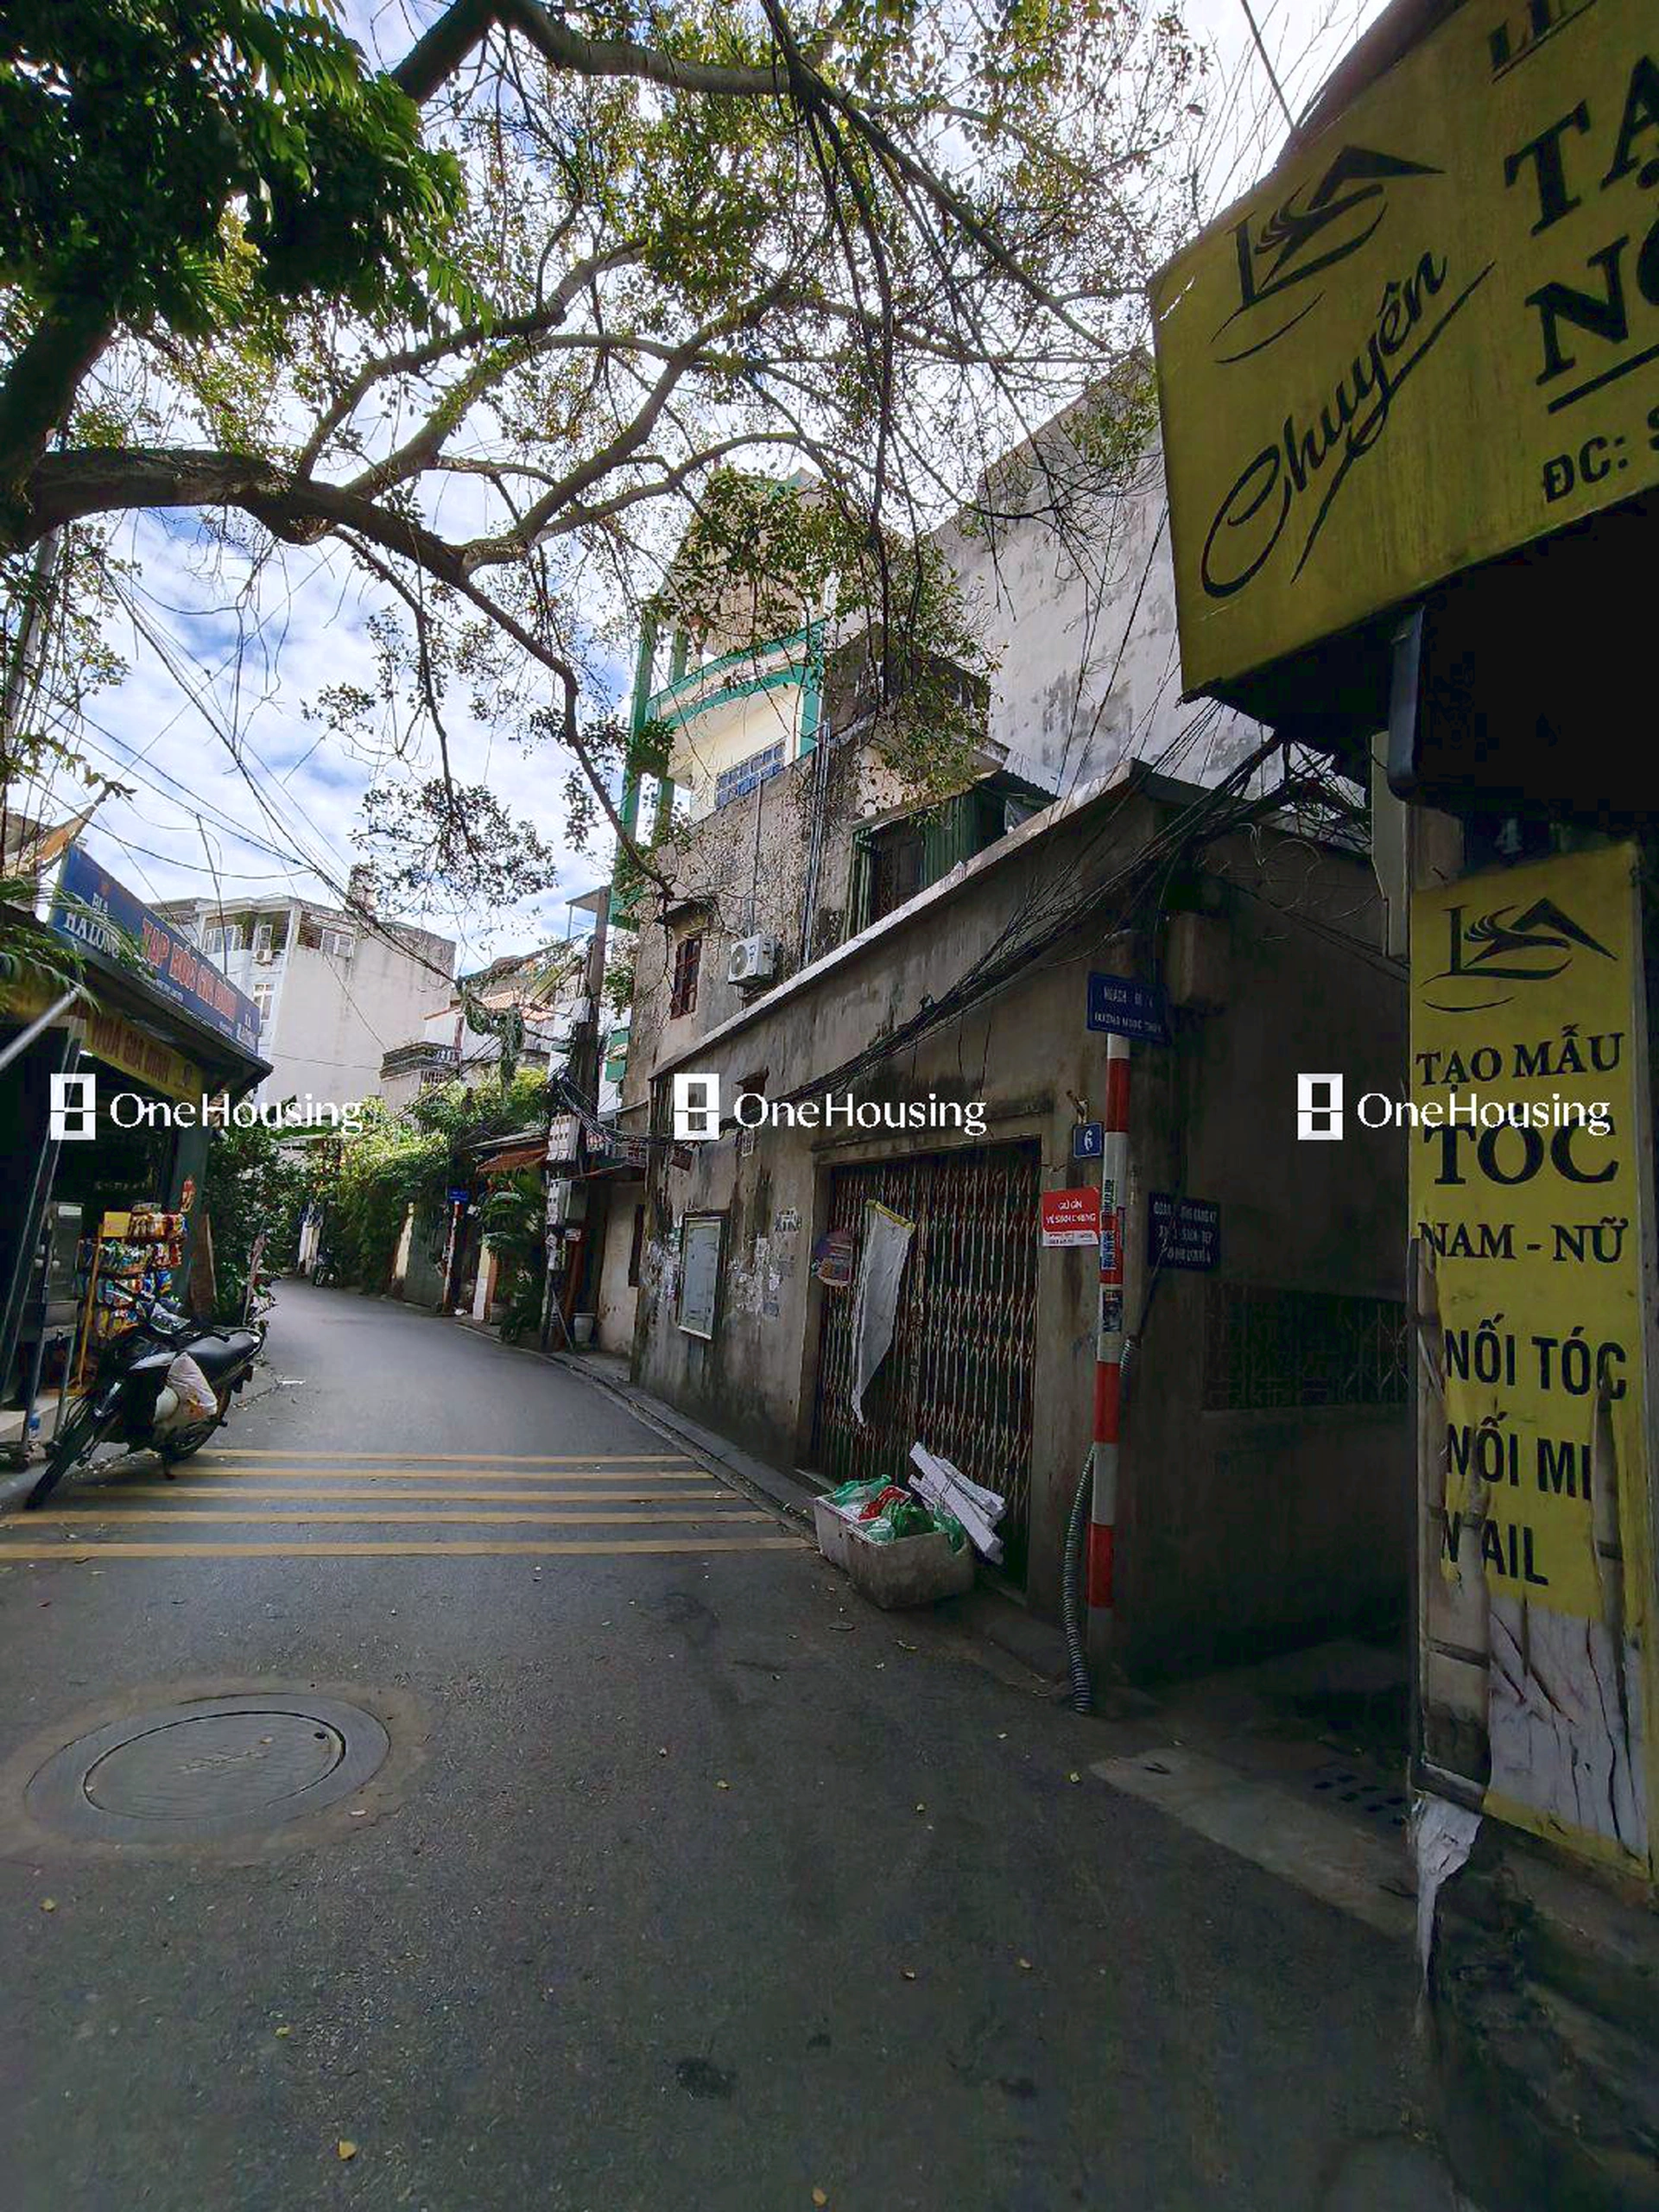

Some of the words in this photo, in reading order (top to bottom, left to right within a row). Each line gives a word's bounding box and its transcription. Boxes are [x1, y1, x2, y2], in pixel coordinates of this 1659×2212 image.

[1543, 434, 1629, 504] ĐC:
[1415, 1046, 1504, 1093] TẠO
[1513, 1024, 1625, 1078] MẪU
[1417, 1221, 1516, 1260] NAM
[1550, 1216, 1629, 1264] NỮ
[1444, 1313, 1516, 1387] NỐI
[1530, 1326, 1627, 1402] TÓC
[1445, 1410, 1520, 1487] NỐI
